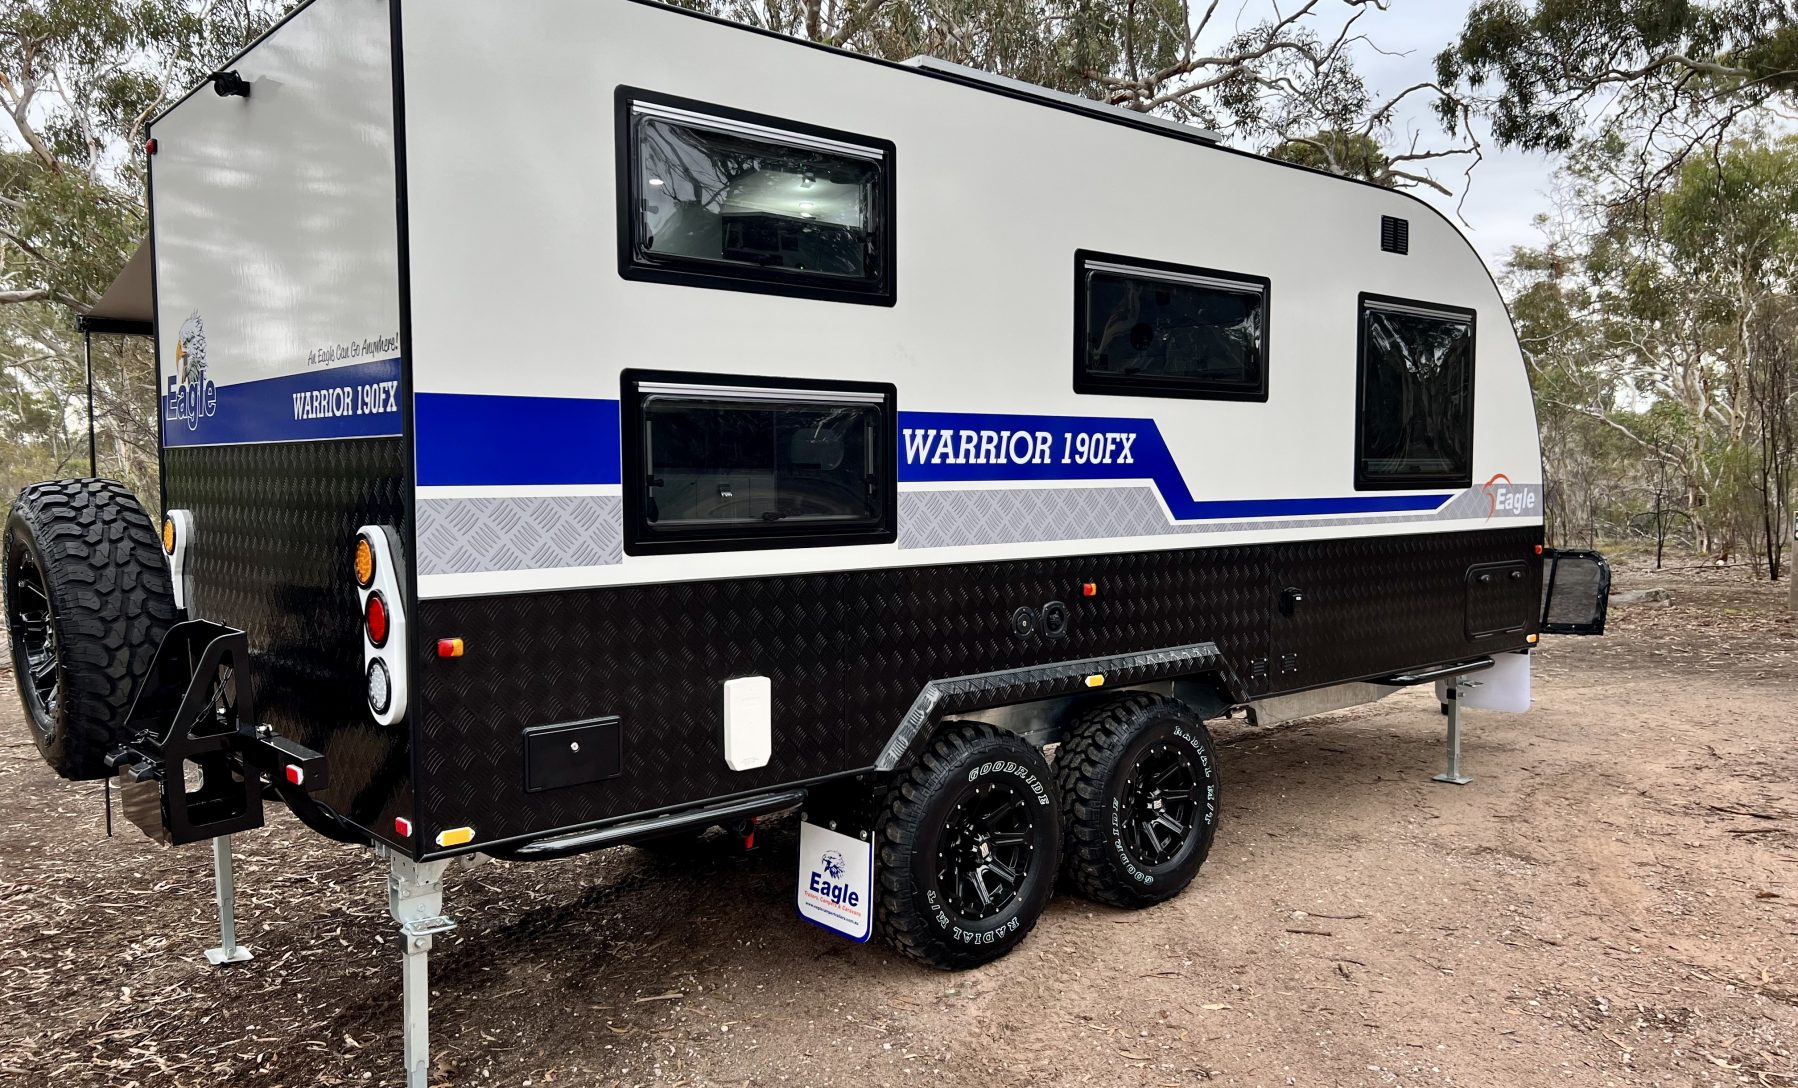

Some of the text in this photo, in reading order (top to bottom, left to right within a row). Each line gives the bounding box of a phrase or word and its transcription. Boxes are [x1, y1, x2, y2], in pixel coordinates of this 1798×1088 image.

[307, 332, 399, 366] An Eagle Can Go Anywhere!
[166, 368, 217, 431] Eagle
[292, 380, 398, 421] WARRIOR 190FX
[902, 428, 1137, 465] WARRIOR 190FX
[1495, 487, 1536, 515] Eagle
[1173, 725, 1213, 778] RADIAL
[968, 760, 1050, 806] GOODRIDE
[1111, 796, 1154, 886] GOODRIDE
[809, 871, 859, 907] Eagle
[926, 889, 1020, 945] RADIAL M/T
